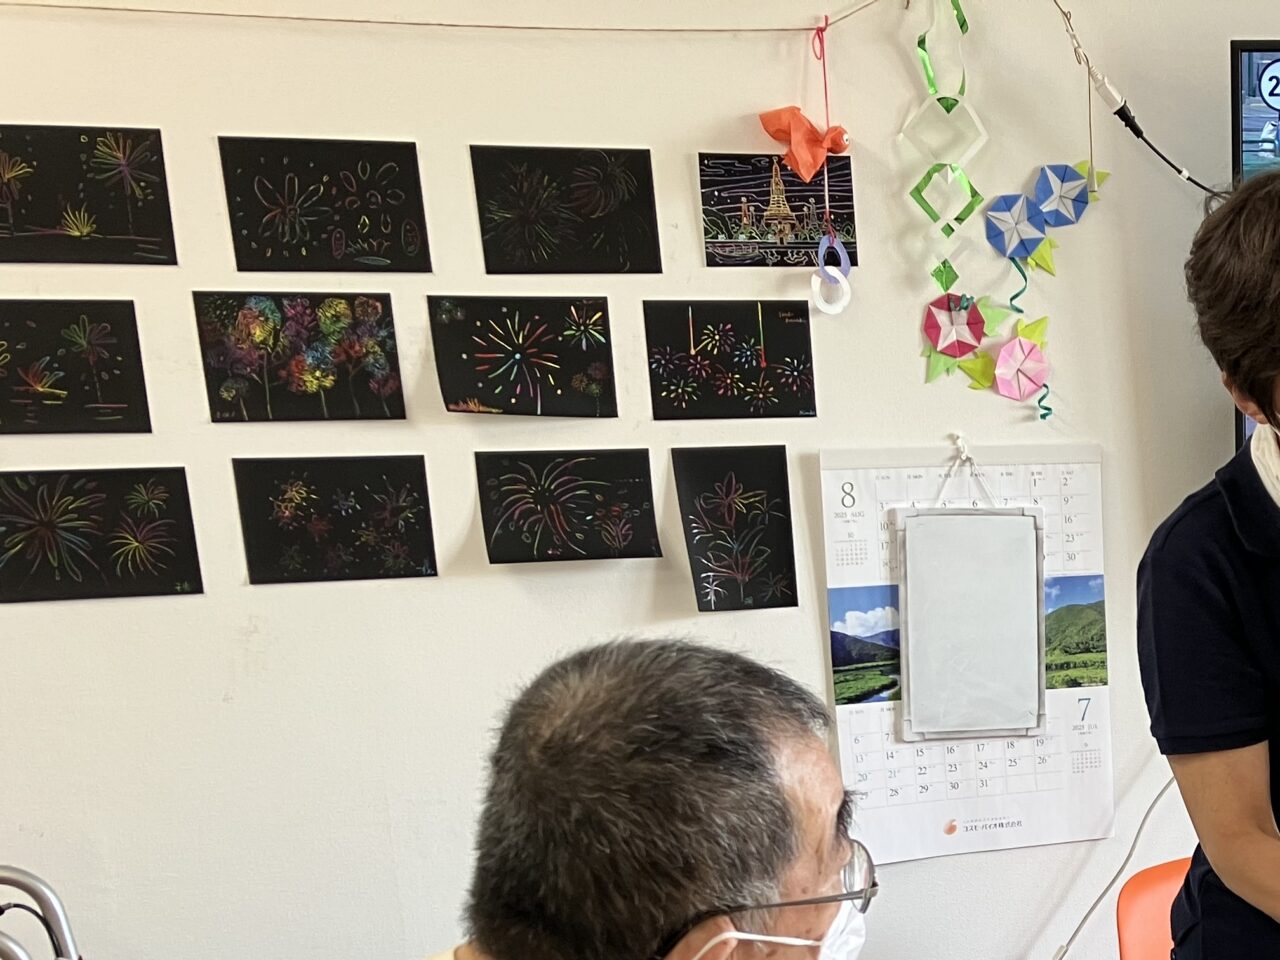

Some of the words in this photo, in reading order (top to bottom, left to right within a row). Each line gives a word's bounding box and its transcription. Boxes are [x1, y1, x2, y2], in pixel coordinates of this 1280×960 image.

[1062, 477, 1068, 486] 2
[841, 481, 856, 508] 8
[1063, 496, 1069, 505] 9
[1064, 515, 1073, 524] 16
[880, 541, 889, 550] 17
[1065, 534, 1075, 543] 23
[1066, 552, 1076, 561] 30
[1078, 697, 1092, 722] 7
[886, 751, 894, 760] 14
[916, 748, 925, 757] 15
[946, 745, 955, 754] 16
[977, 743, 985, 752] 17
[1006, 741, 1015, 750] 18
[1036, 738, 1045, 747] 19
[857, 772, 868, 782] 20
[888, 769, 897, 779] 21
[917, 766, 927, 776] 22
[948, 764, 958, 773] 23
[979, 761, 988, 770] 24
[1008, 758, 1018, 767] 25
[1038, 756, 1047, 765] 26
[889, 788, 899, 797] 28
[919, 785, 929, 794] 29
[949, 781, 959, 791] 30
[980, 778, 988, 788] 31
